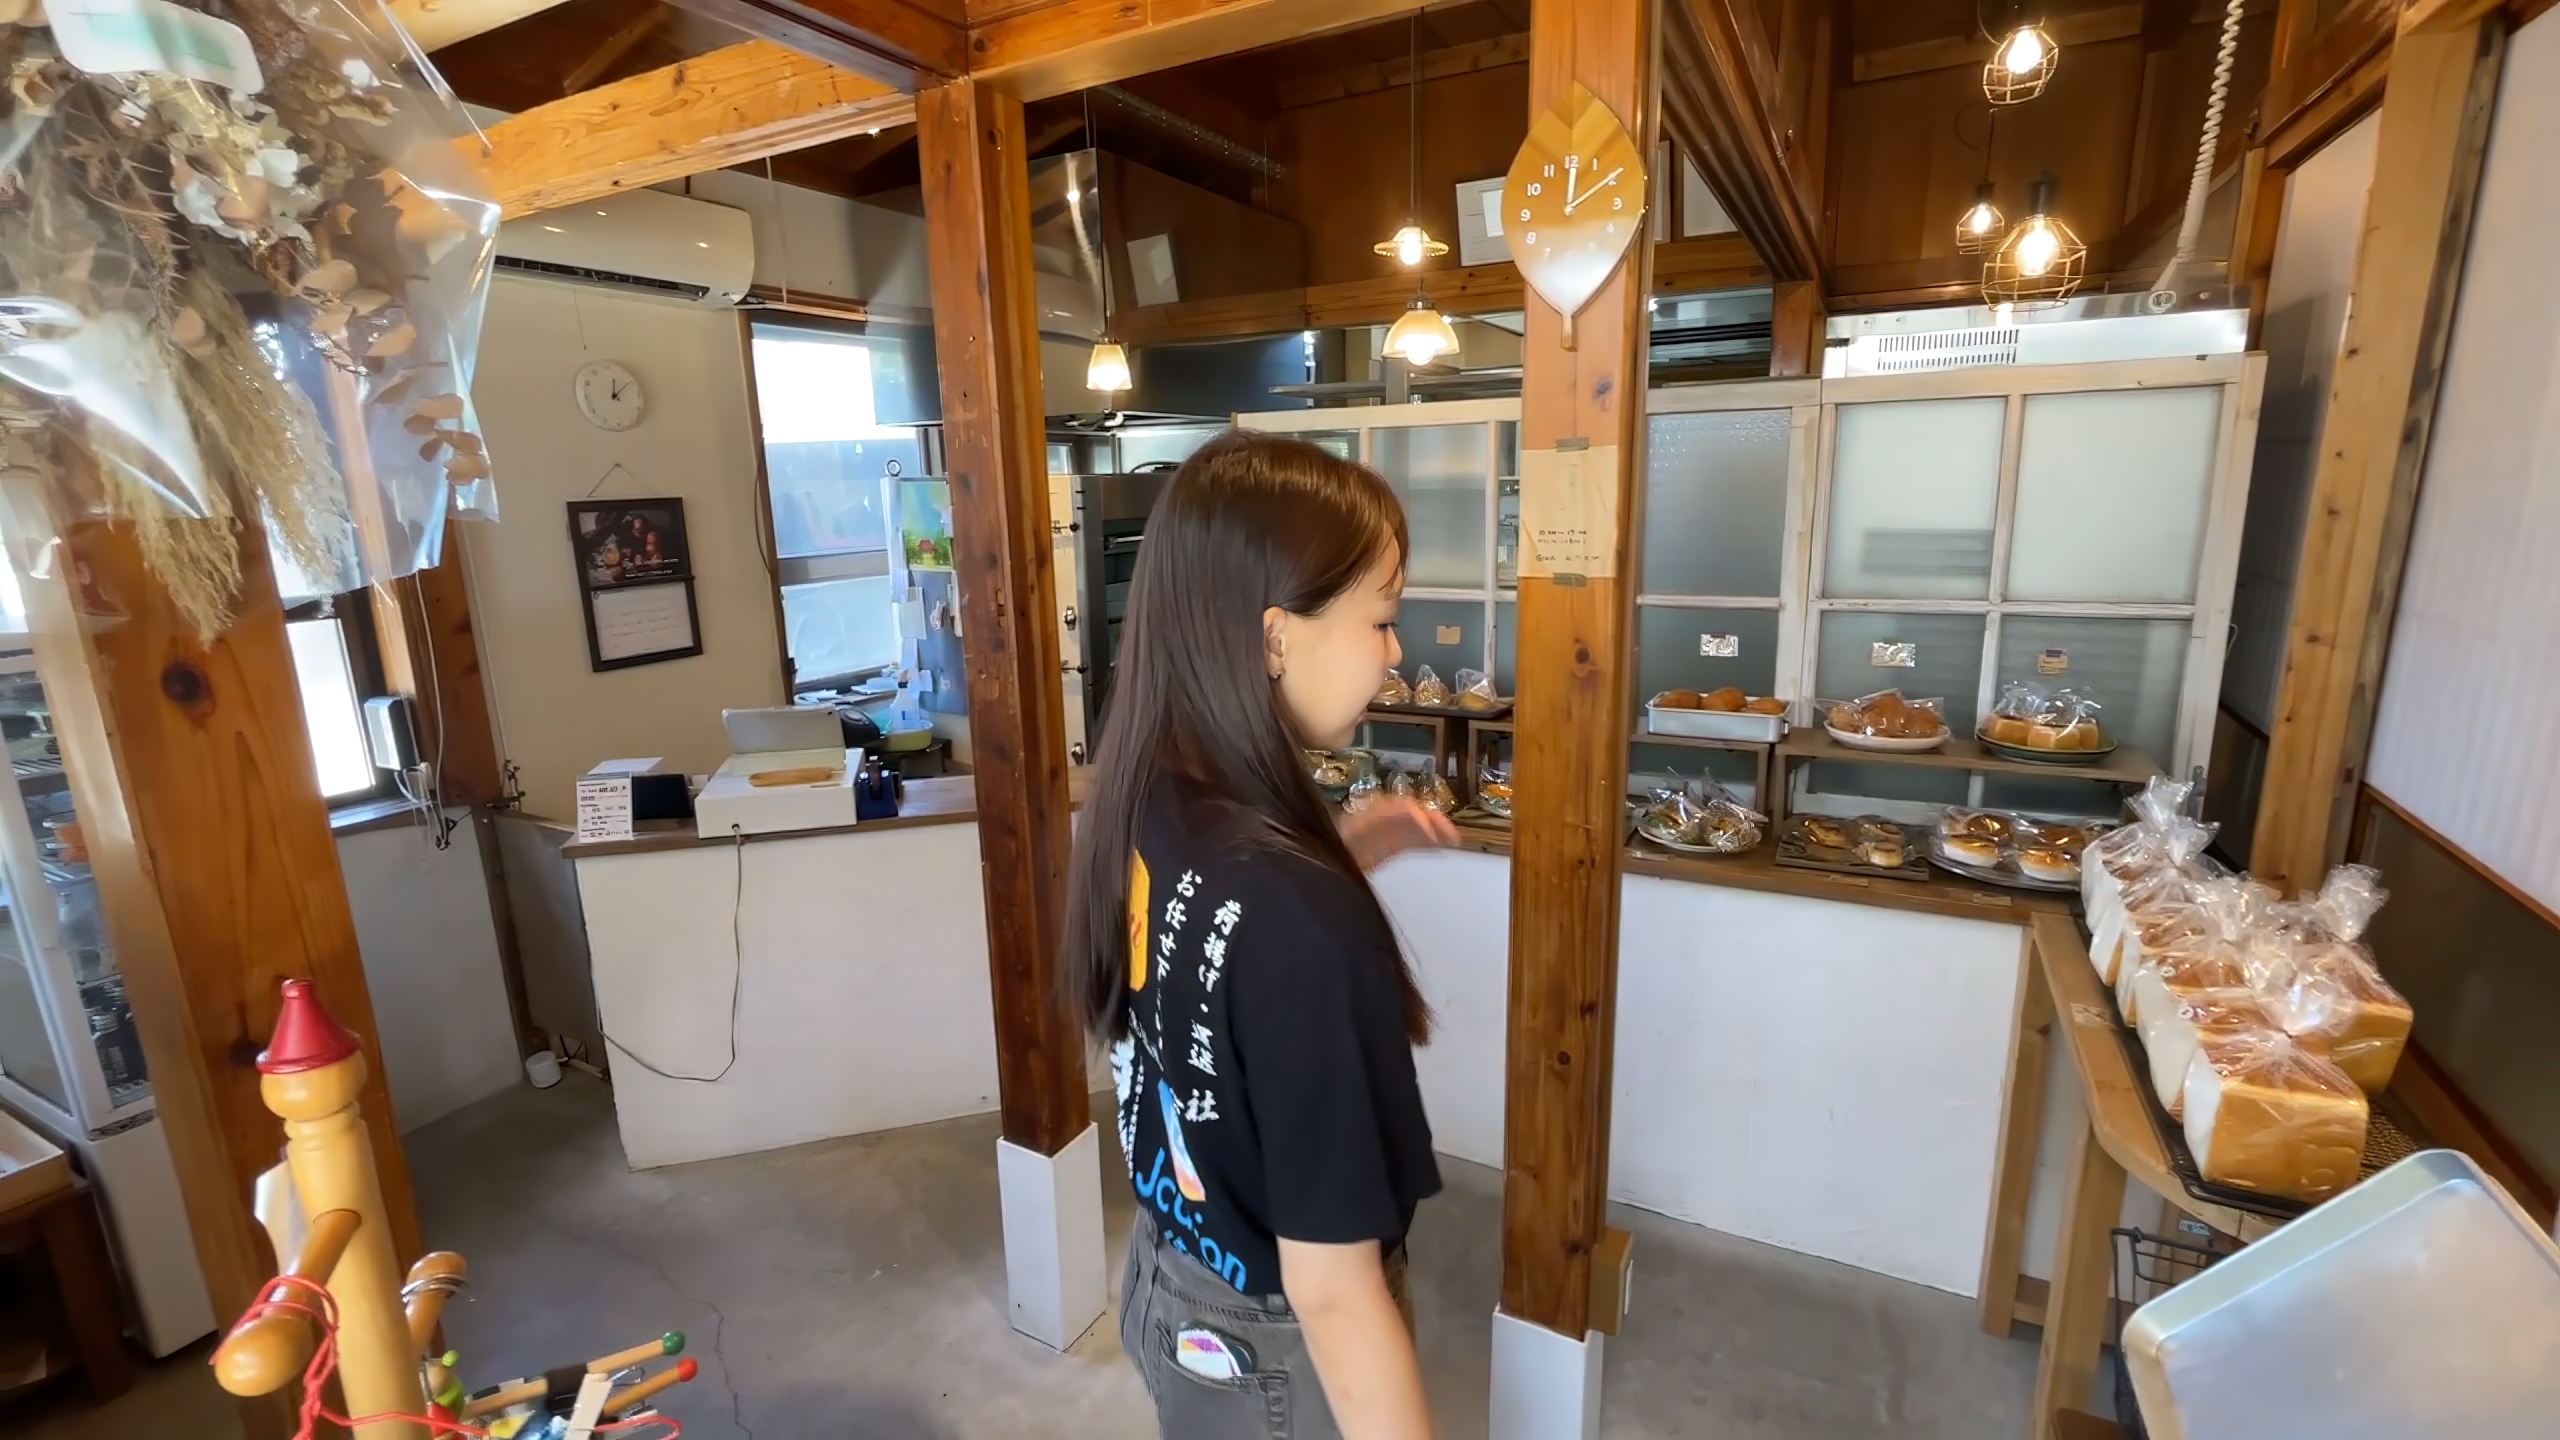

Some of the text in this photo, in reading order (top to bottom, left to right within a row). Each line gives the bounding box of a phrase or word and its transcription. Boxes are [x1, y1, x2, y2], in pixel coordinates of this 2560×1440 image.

[1564, 154, 1579, 169] 12
[1592, 157, 1598, 171] 1
[1543, 164, 1555, 178] 11
[1526, 183, 1542, 197] 10
[1613, 197, 1622, 210] 3
[1520, 208, 1531, 222] 9
